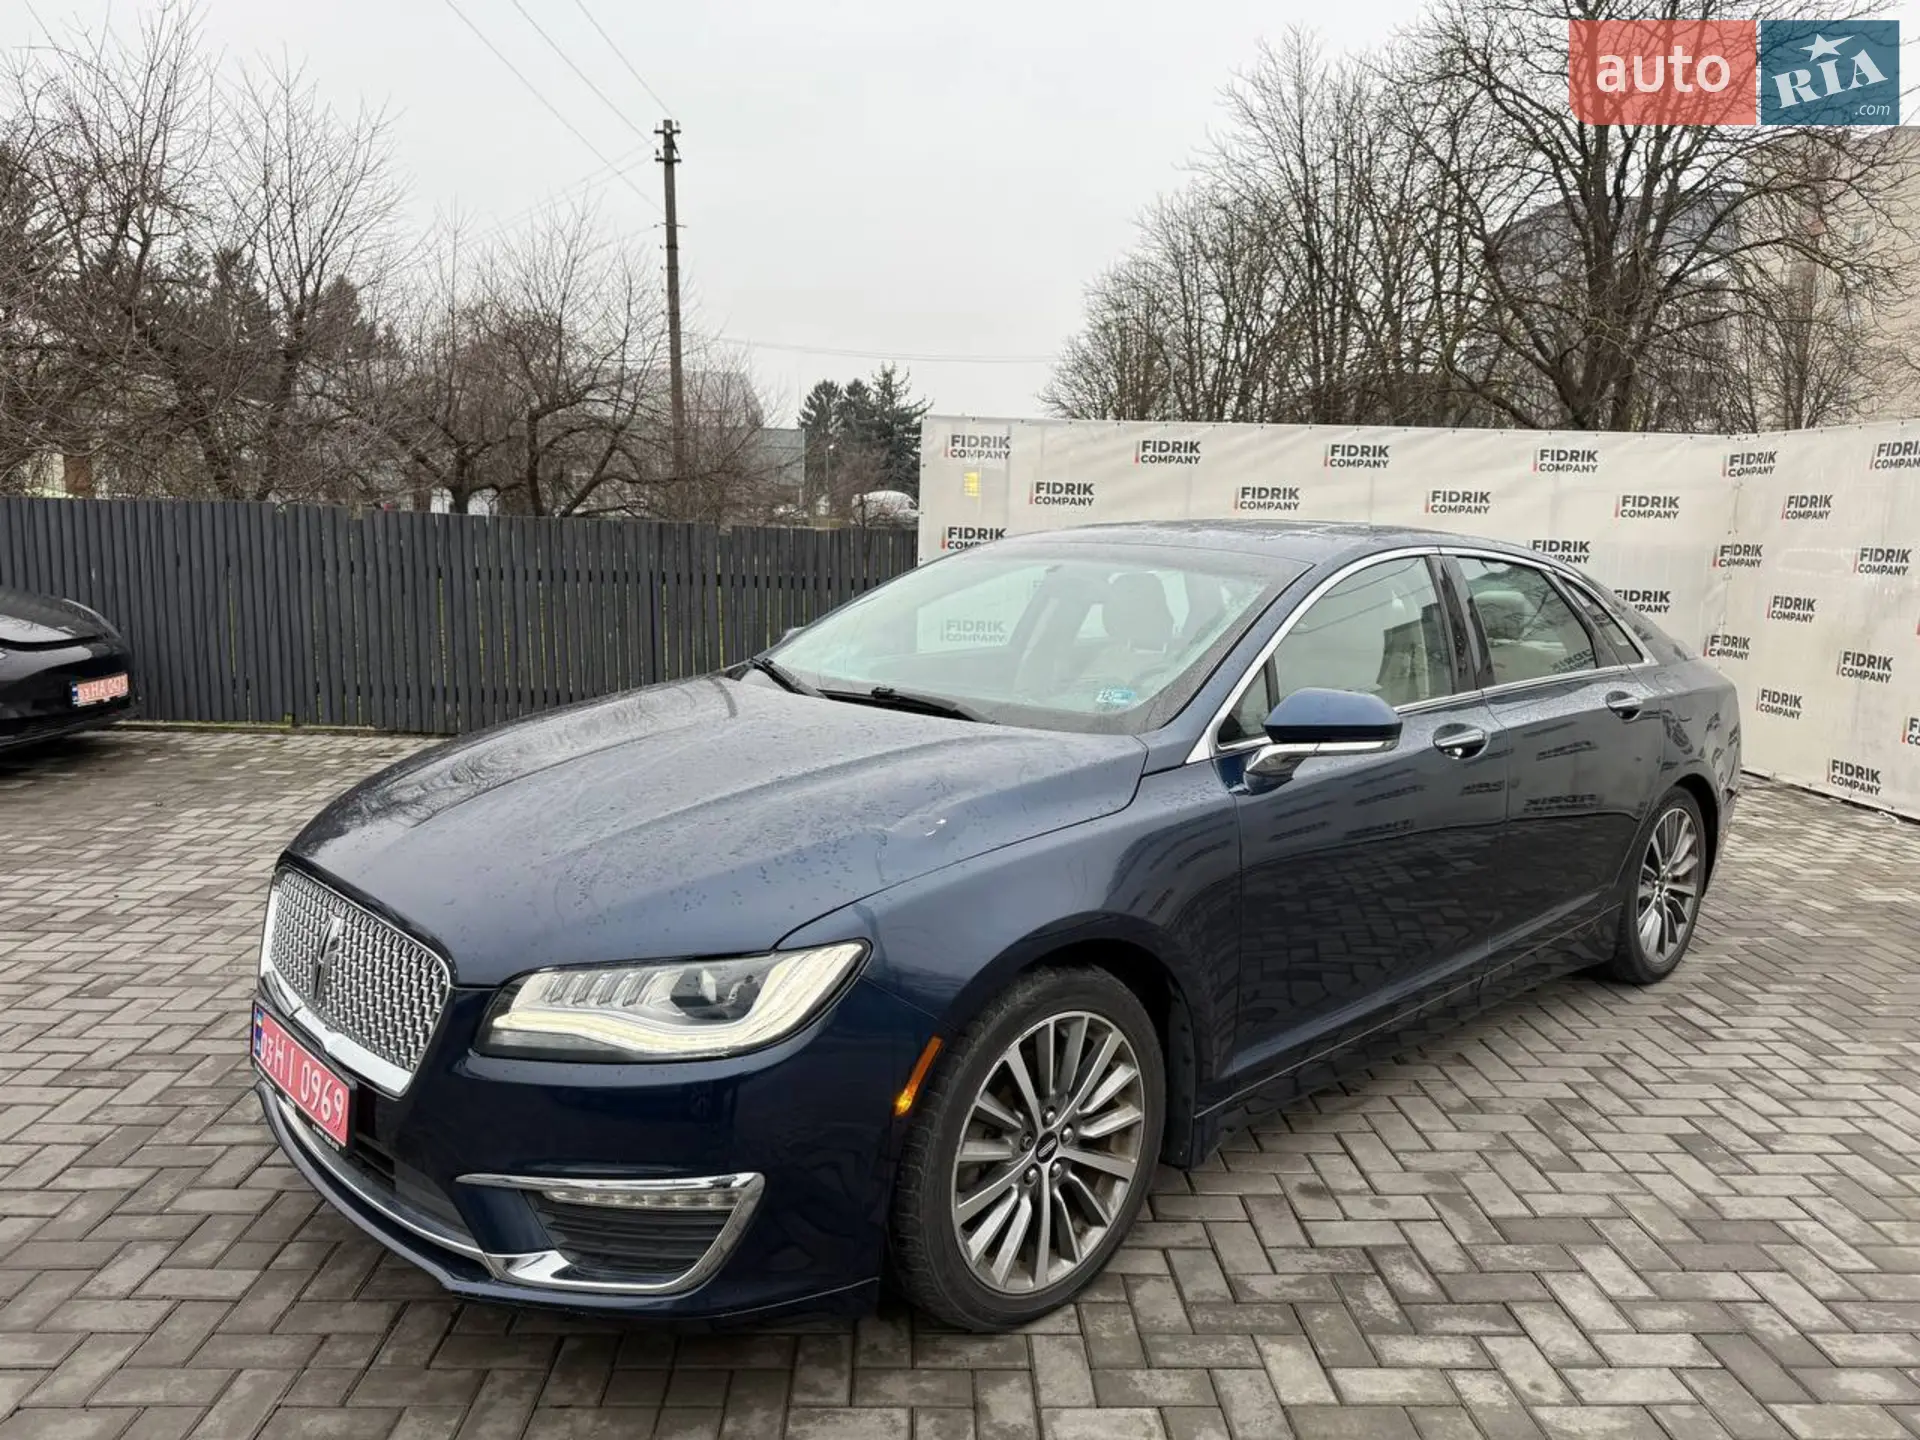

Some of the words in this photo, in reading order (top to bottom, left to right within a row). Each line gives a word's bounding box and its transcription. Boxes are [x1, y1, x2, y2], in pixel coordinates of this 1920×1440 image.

[950, 435, 1010, 449] FIDRIK
[1142, 440, 1200, 454] FIDRIK
[950, 449, 1010, 460] COMPANY
[1331, 444, 1389, 458] FIDRIK
[1540, 449, 1598, 462] FIDRIK
[1877, 441, 1920, 457] FIDRI
[1141, 455, 1200, 464] COMPANY
[1330, 458, 1389, 468] COMPANY
[1729, 451, 1777, 466] FIDRIK
[1874, 458, 1920, 469] COMPAN
[1539, 462, 1598, 472] COMPANY
[1035, 482, 1094, 496] FIDRIK
[1241, 487, 1299, 500] FIDRIK
[1034, 496, 1094, 506] COMPANY
[1432, 491, 1491, 505] FIDRIK
[1622, 495, 1679, 509] FIDRIK
[1787, 495, 1833, 508] FIDRIK
[1240, 500, 1300, 511] COMPANY
[1431, 504, 1490, 514] COMPANY
[1620, 509, 1679, 519] COMPANY
[1785, 509, 1830, 520] COMPANY
[947, 527, 1007, 540] FIDRIK
[1532, 540, 1590, 553] FIDRIK
[1860, 548, 1911, 563] FIDRIK
[1858, 563, 1909, 576] COMPANY
[1772, 595, 1816, 612] FIDRIK
[1771, 611, 1815, 623] COMPANY
[1842, 651, 1893, 671] FIDRIK
[1840, 667, 1892, 684] COMPANY
[1760, 688, 1802, 709] FIDRIK
[1759, 703, 1801, 720] COMPANY
[1831, 759, 1881, 784] FIDRIK
[1830, 774, 1881, 796] COMPANY
[300, 1060, 344, 1127] 0969
